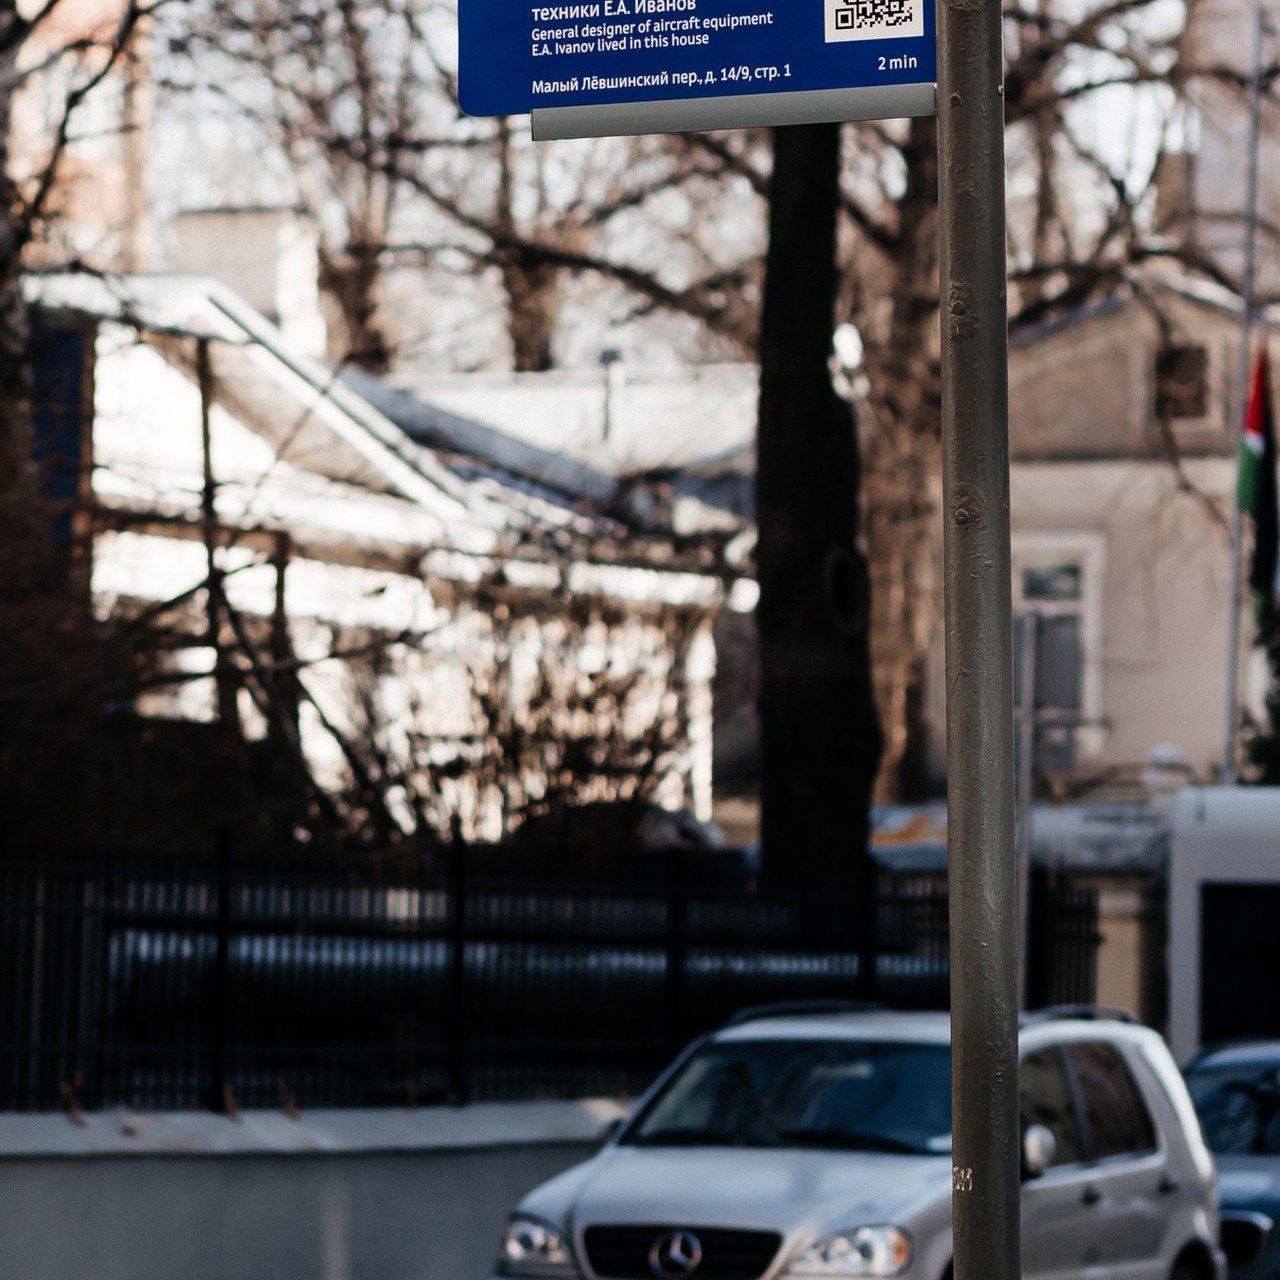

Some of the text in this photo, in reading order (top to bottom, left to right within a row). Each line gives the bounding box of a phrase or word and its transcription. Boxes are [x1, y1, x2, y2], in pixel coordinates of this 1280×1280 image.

[531, 3, 600, 21] техники
[604, 0, 631, 17] Е.А.
[531, 11, 774, 41] General designer of aircraft equipment
[532, 32, 710, 56] E.A. Ivanov lived in this house
[878, 54, 917, 70] 2 min
[531, 64, 792, 94] Малый Лёвшинский пер., д. 14/9, стр. 1
